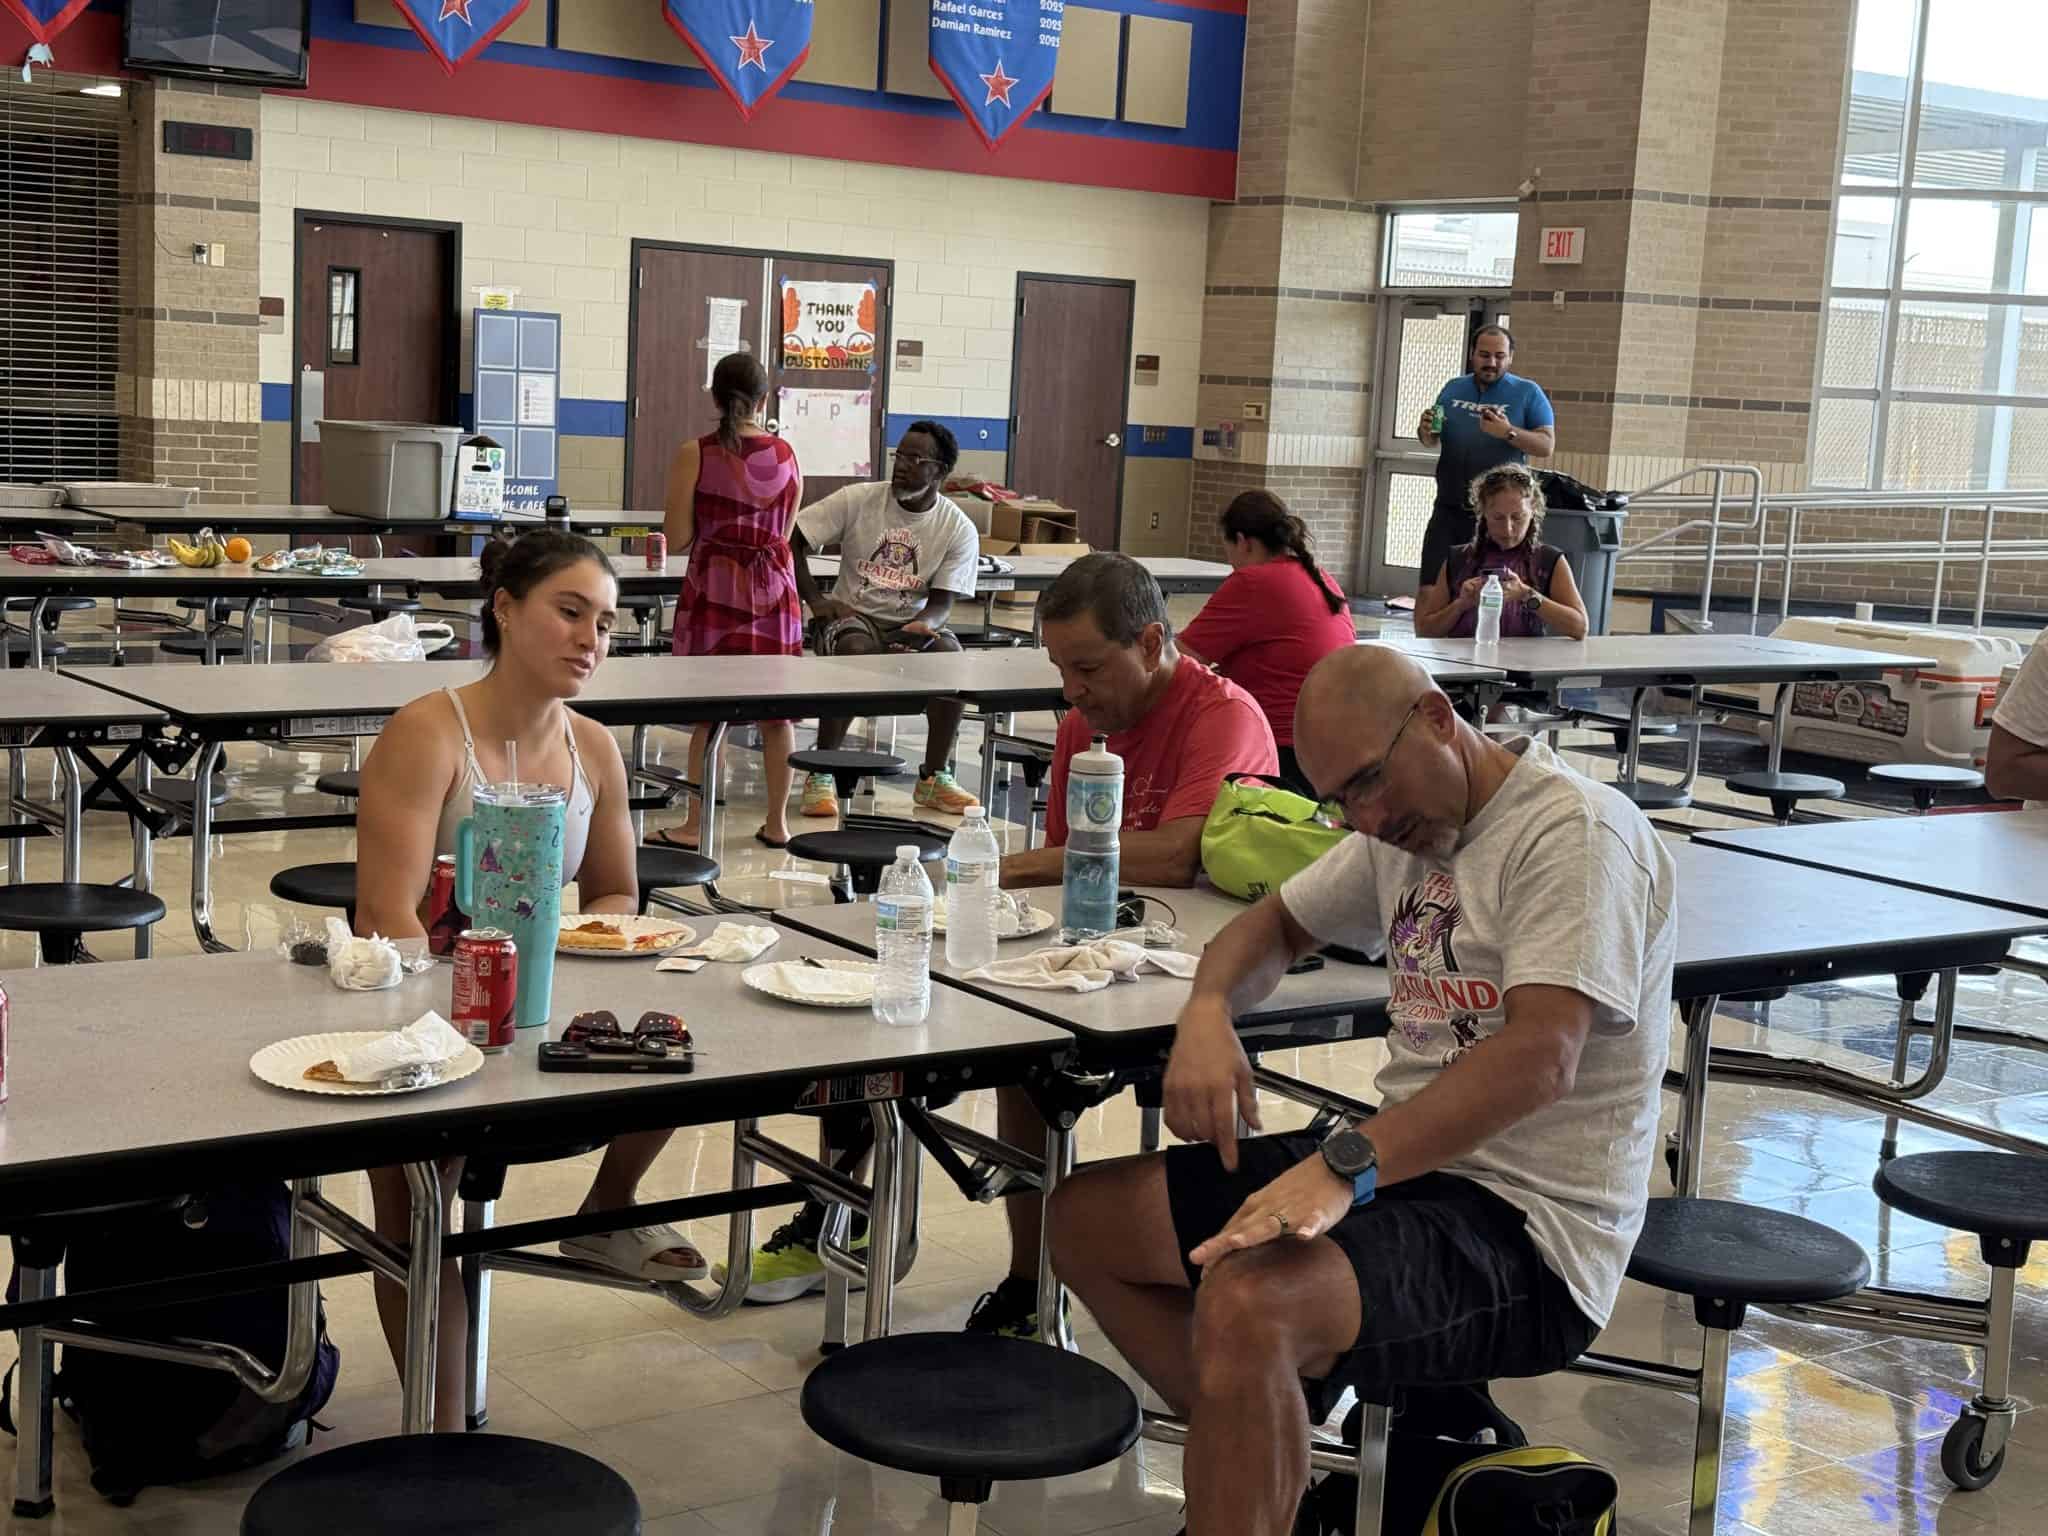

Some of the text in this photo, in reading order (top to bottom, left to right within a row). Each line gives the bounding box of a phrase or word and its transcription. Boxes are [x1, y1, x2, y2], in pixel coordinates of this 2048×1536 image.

[932, 0, 1062, 31] Rafael Garces 2025
[932, 16, 970, 32] Damian
[973, 23, 1012, 39] Ramirez
[1547, 231, 1574, 257] EXIT
[807, 302, 853, 316] THANK
[816, 319, 844, 332] YOU
[785, 355, 872, 369] CUSTODIANS
[503, 484, 540, 496] ELCOME
